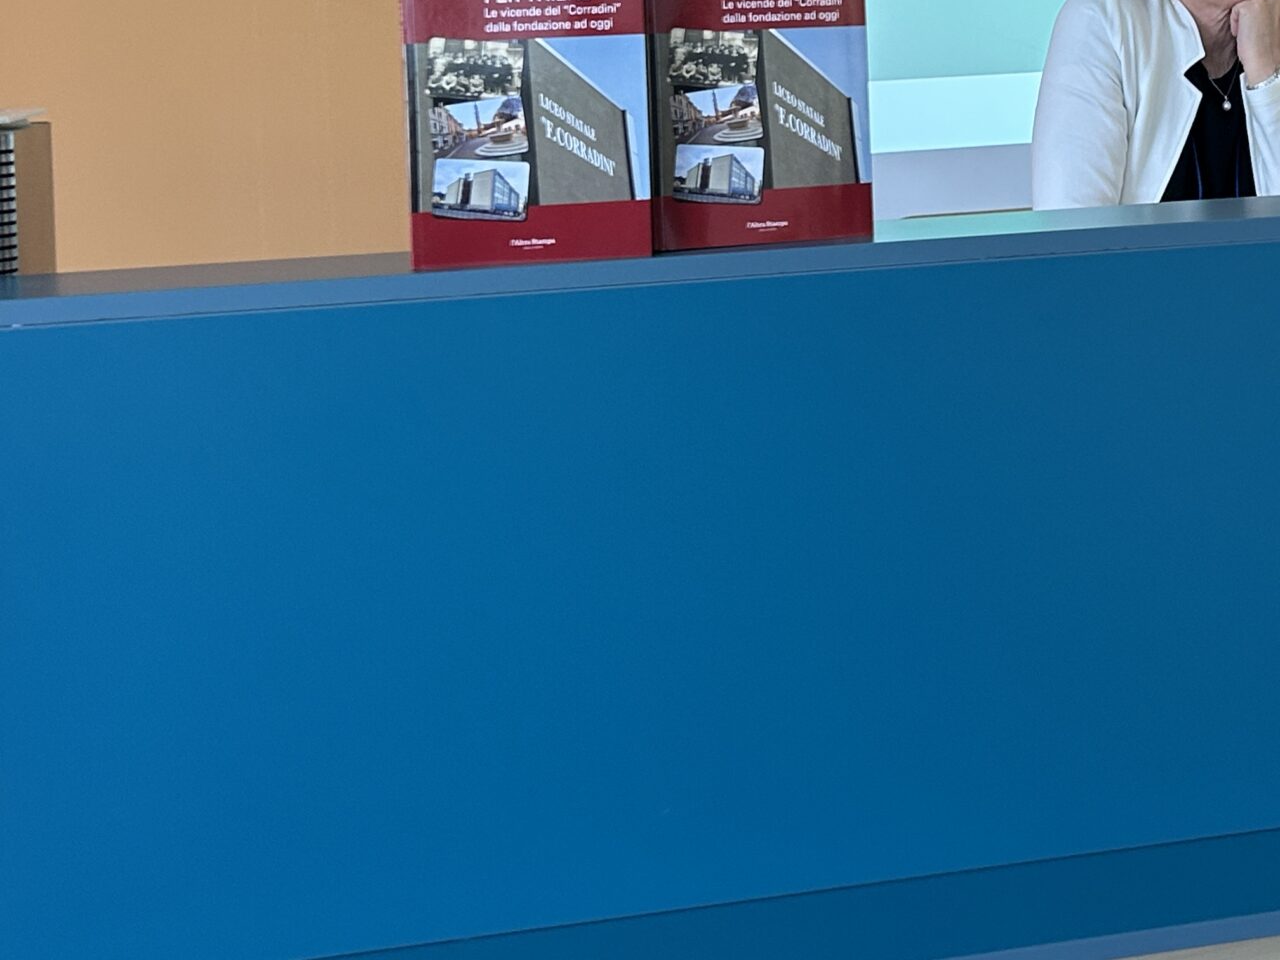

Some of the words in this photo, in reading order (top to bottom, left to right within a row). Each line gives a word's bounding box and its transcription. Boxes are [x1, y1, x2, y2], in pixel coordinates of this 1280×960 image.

[484, 7, 498, 18] Le
[500, 6, 542, 18] vicende
[545, 5, 561, 16] del
[722, 0, 734, 10] Le
[723, 13, 746, 24] dalla
[749, 10, 802, 23] fondazione
[804, 9, 816, 20] ad
[818, 9, 840, 22] oggi
[484, 21, 511, 33] dalla
[513, 19, 571, 32] fondazione
[573, 18, 587, 29] ad
[590, 17, 613, 31] oggi
[773, 81, 797, 108] LICEO
[797, 98, 825, 128] STATALE
[539, 93, 566, 120] LICEO
[566, 111, 597, 141] STATALE
